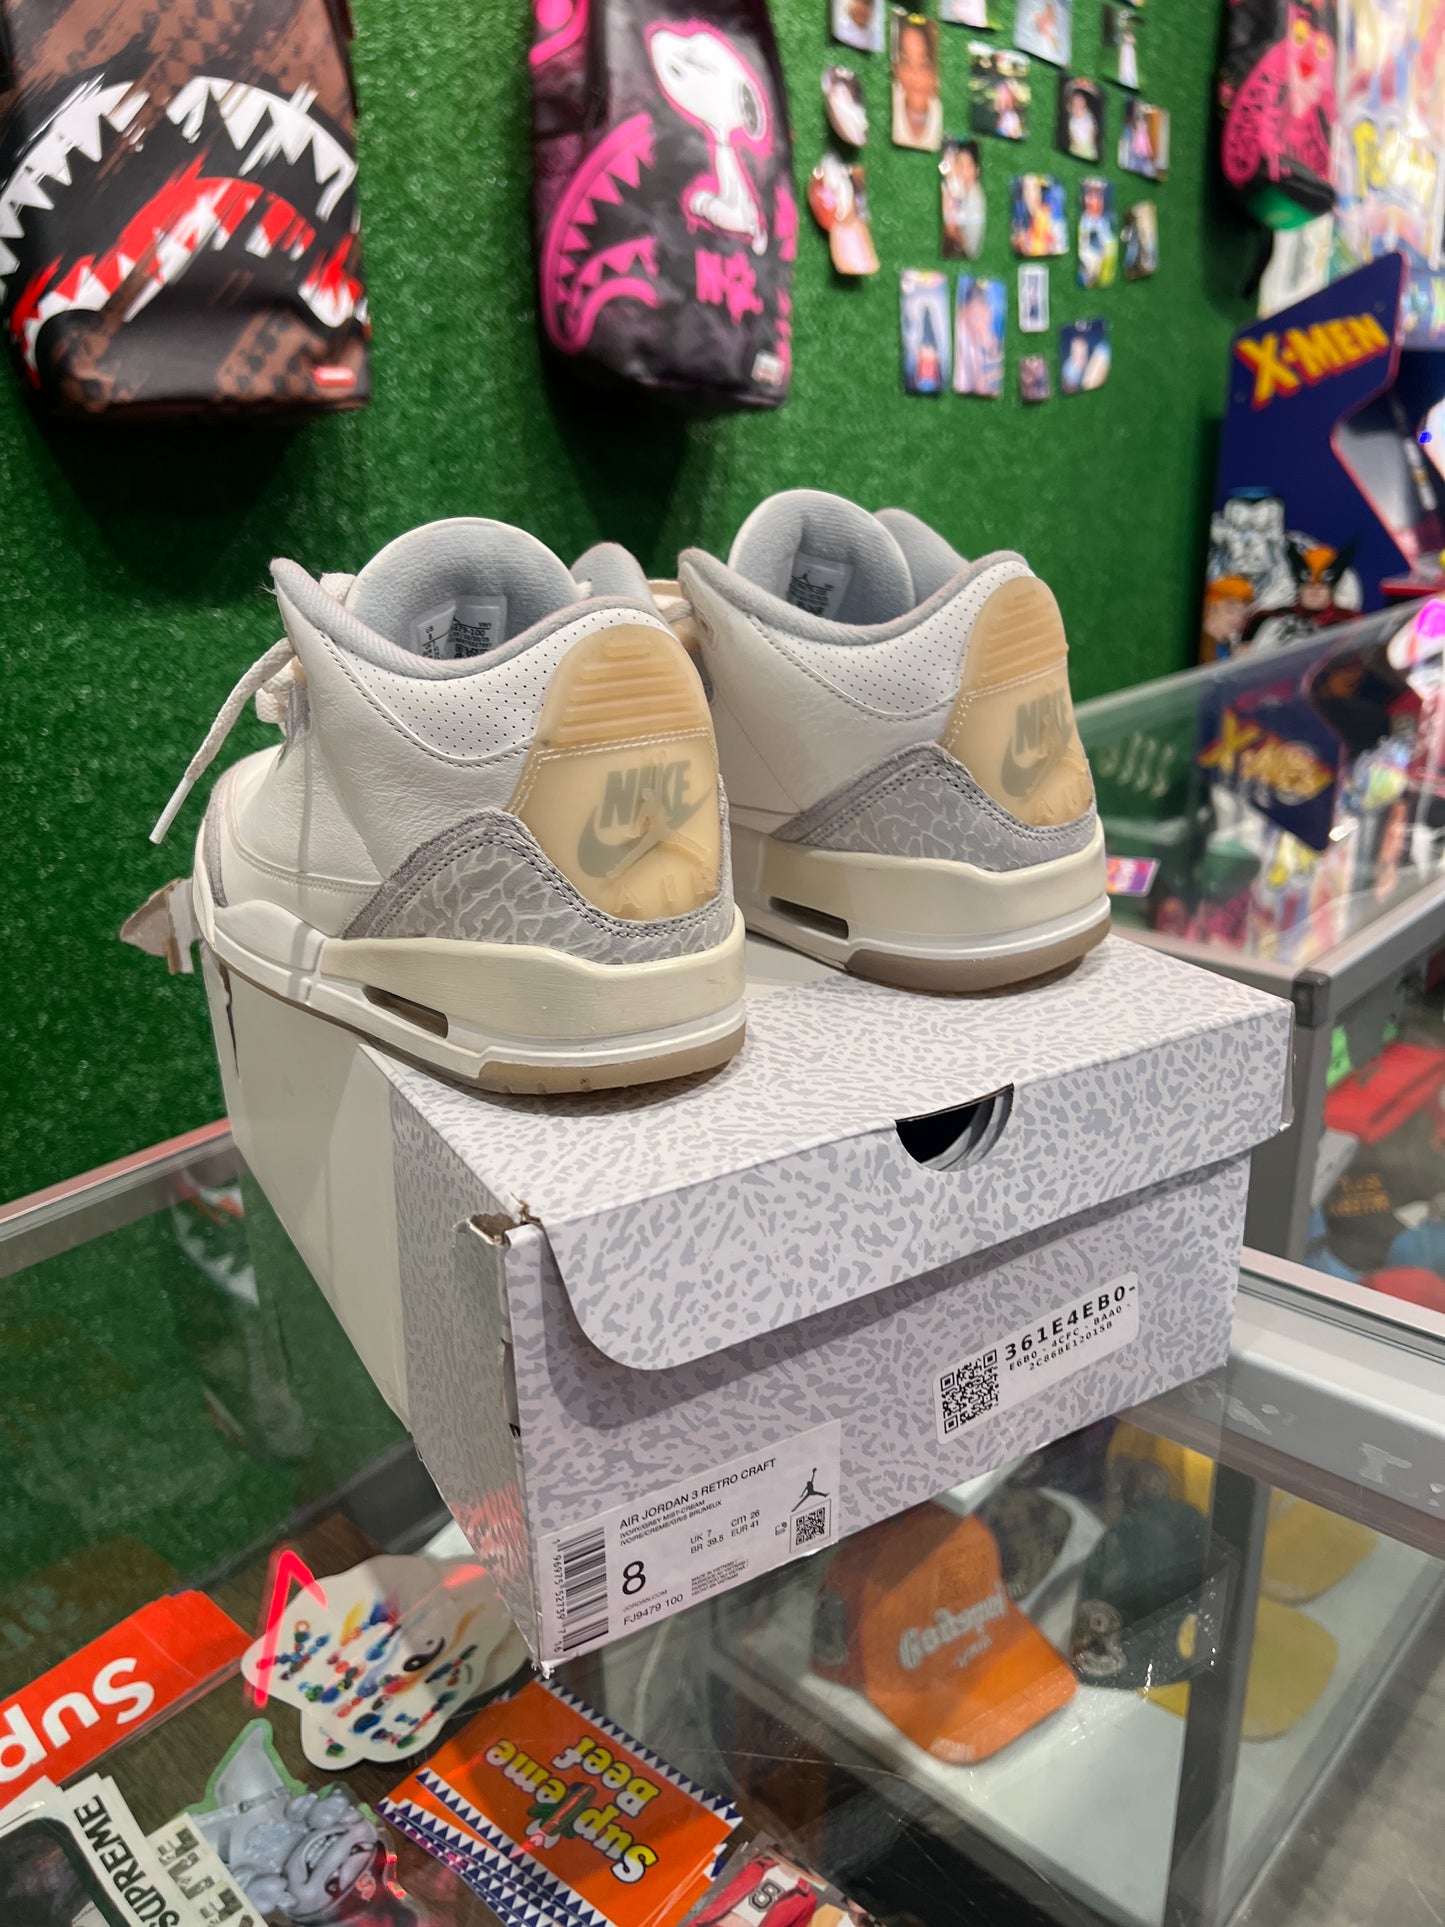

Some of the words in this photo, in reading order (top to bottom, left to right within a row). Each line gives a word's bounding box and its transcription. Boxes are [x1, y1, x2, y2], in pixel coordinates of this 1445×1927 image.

[1235, 313, 1390, 412] X-MEN
[600, 760, 691, 829] NIKE
[1005, 1286, 1136, 1361] 361E4EB0-
[619, 1513, 640, 1529] AIR
[642, 1493, 689, 1521] JORDAN
[692, 1490, 699, 1501] 3
[701, 1474, 738, 1496] RETRO
[740, 1458, 776, 1480] CRAFT
[730, 1524, 748, 1538] EUR
[750, 1519, 760, 1529] 41
[731, 1515, 747, 1528] cm
[750, 1509, 760, 1520] 26
[690, 1534, 704, 1545] UK
[706, 1529, 712, 1538] 7
[690, 1543, 704, 1554] BR
[707, 1535, 724, 1548] 39.5
[553, 1554, 563, 1586] 96975
[622, 1560, 647, 1596] 8
[622, 1589, 668, 1613] JORDAN.COM
[623, 1602, 662, 1625] FJ9479
[665, 1593, 684, 1607] 100
[551, 1735, 662, 1818] Beef
